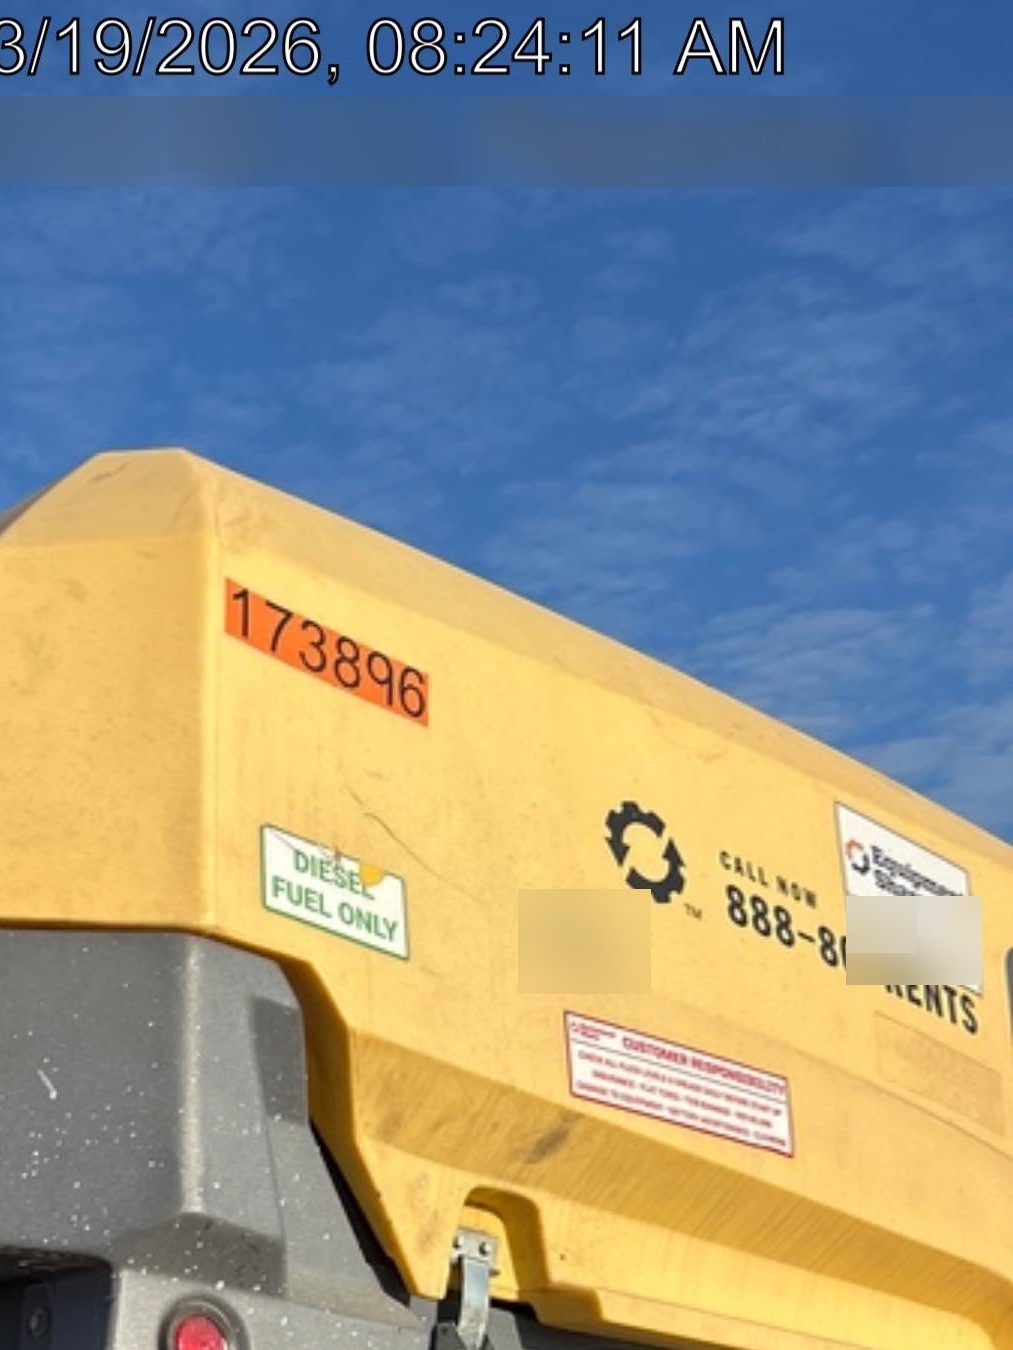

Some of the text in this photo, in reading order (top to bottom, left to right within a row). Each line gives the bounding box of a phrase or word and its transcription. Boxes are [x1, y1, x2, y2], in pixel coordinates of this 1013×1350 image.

[232, 587, 427, 718] 173896
[719, 850, 817, 910] CALL NOW
[871, 845, 964, 896] Equipme
[271, 875, 399, 942] FUEL ONLY
[684, 902, 703, 921] TM
[885, 984, 978, 1034] ENTS
